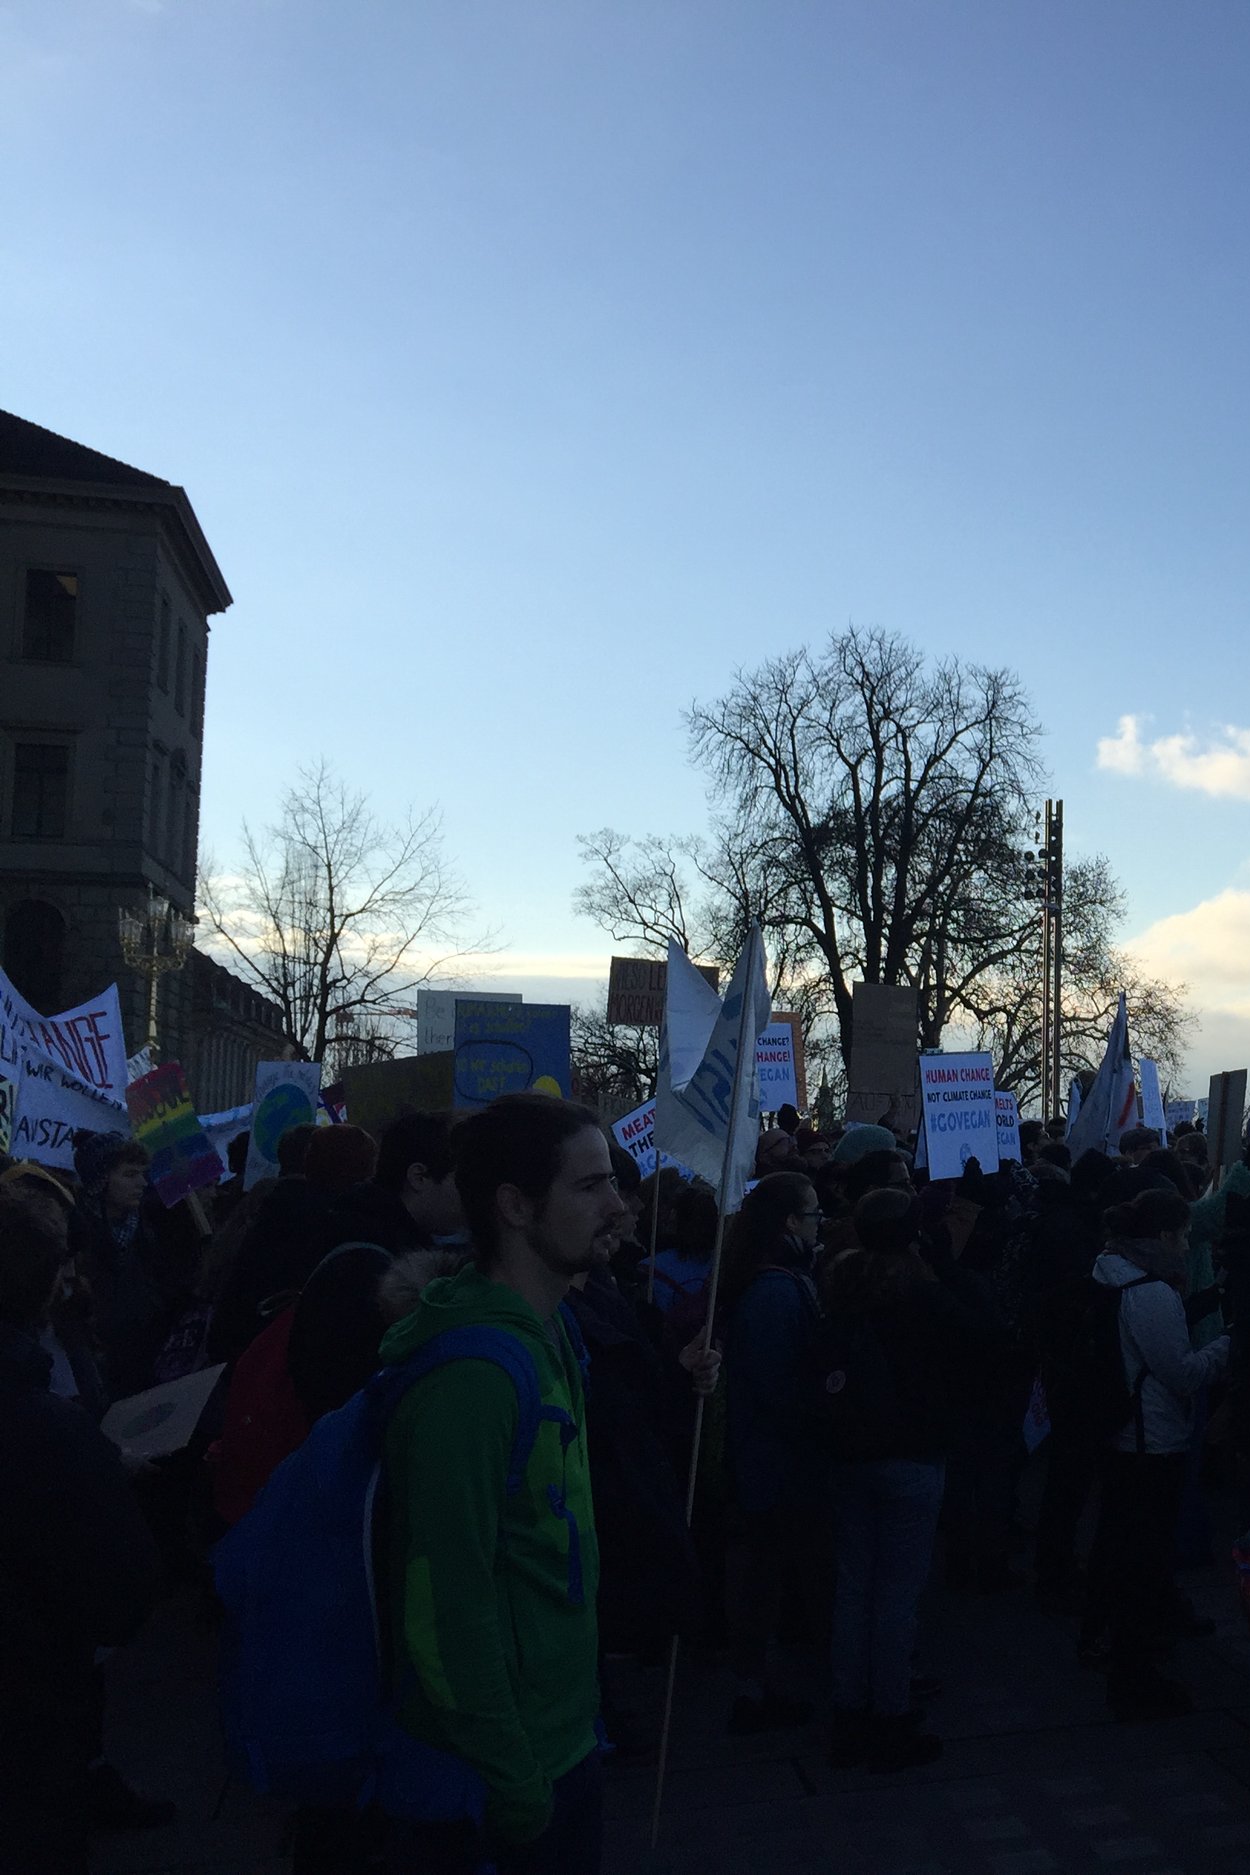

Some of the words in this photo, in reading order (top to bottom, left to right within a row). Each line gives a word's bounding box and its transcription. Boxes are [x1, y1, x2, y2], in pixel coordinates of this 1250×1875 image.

[757, 1037, 790, 1046] CHANGE?
[756, 1050, 791, 1062] HANGE!
[26, 1060, 53, 1082] WIR
[758, 1067, 790, 1081] EGAN
[925, 1069, 958, 1084] HUMAN
[960, 1067, 991, 1081] CHANGE
[927, 1092, 940, 1103] NOT
[943, 1090, 968, 1102] CLIMATE
[969, 1089, 992, 1100] CHANGE
[621, 1108, 656, 1141] MEAT
[931, 1109, 991, 1133] #GOVEGAN
[996, 1114, 1015, 1127] ORLD
